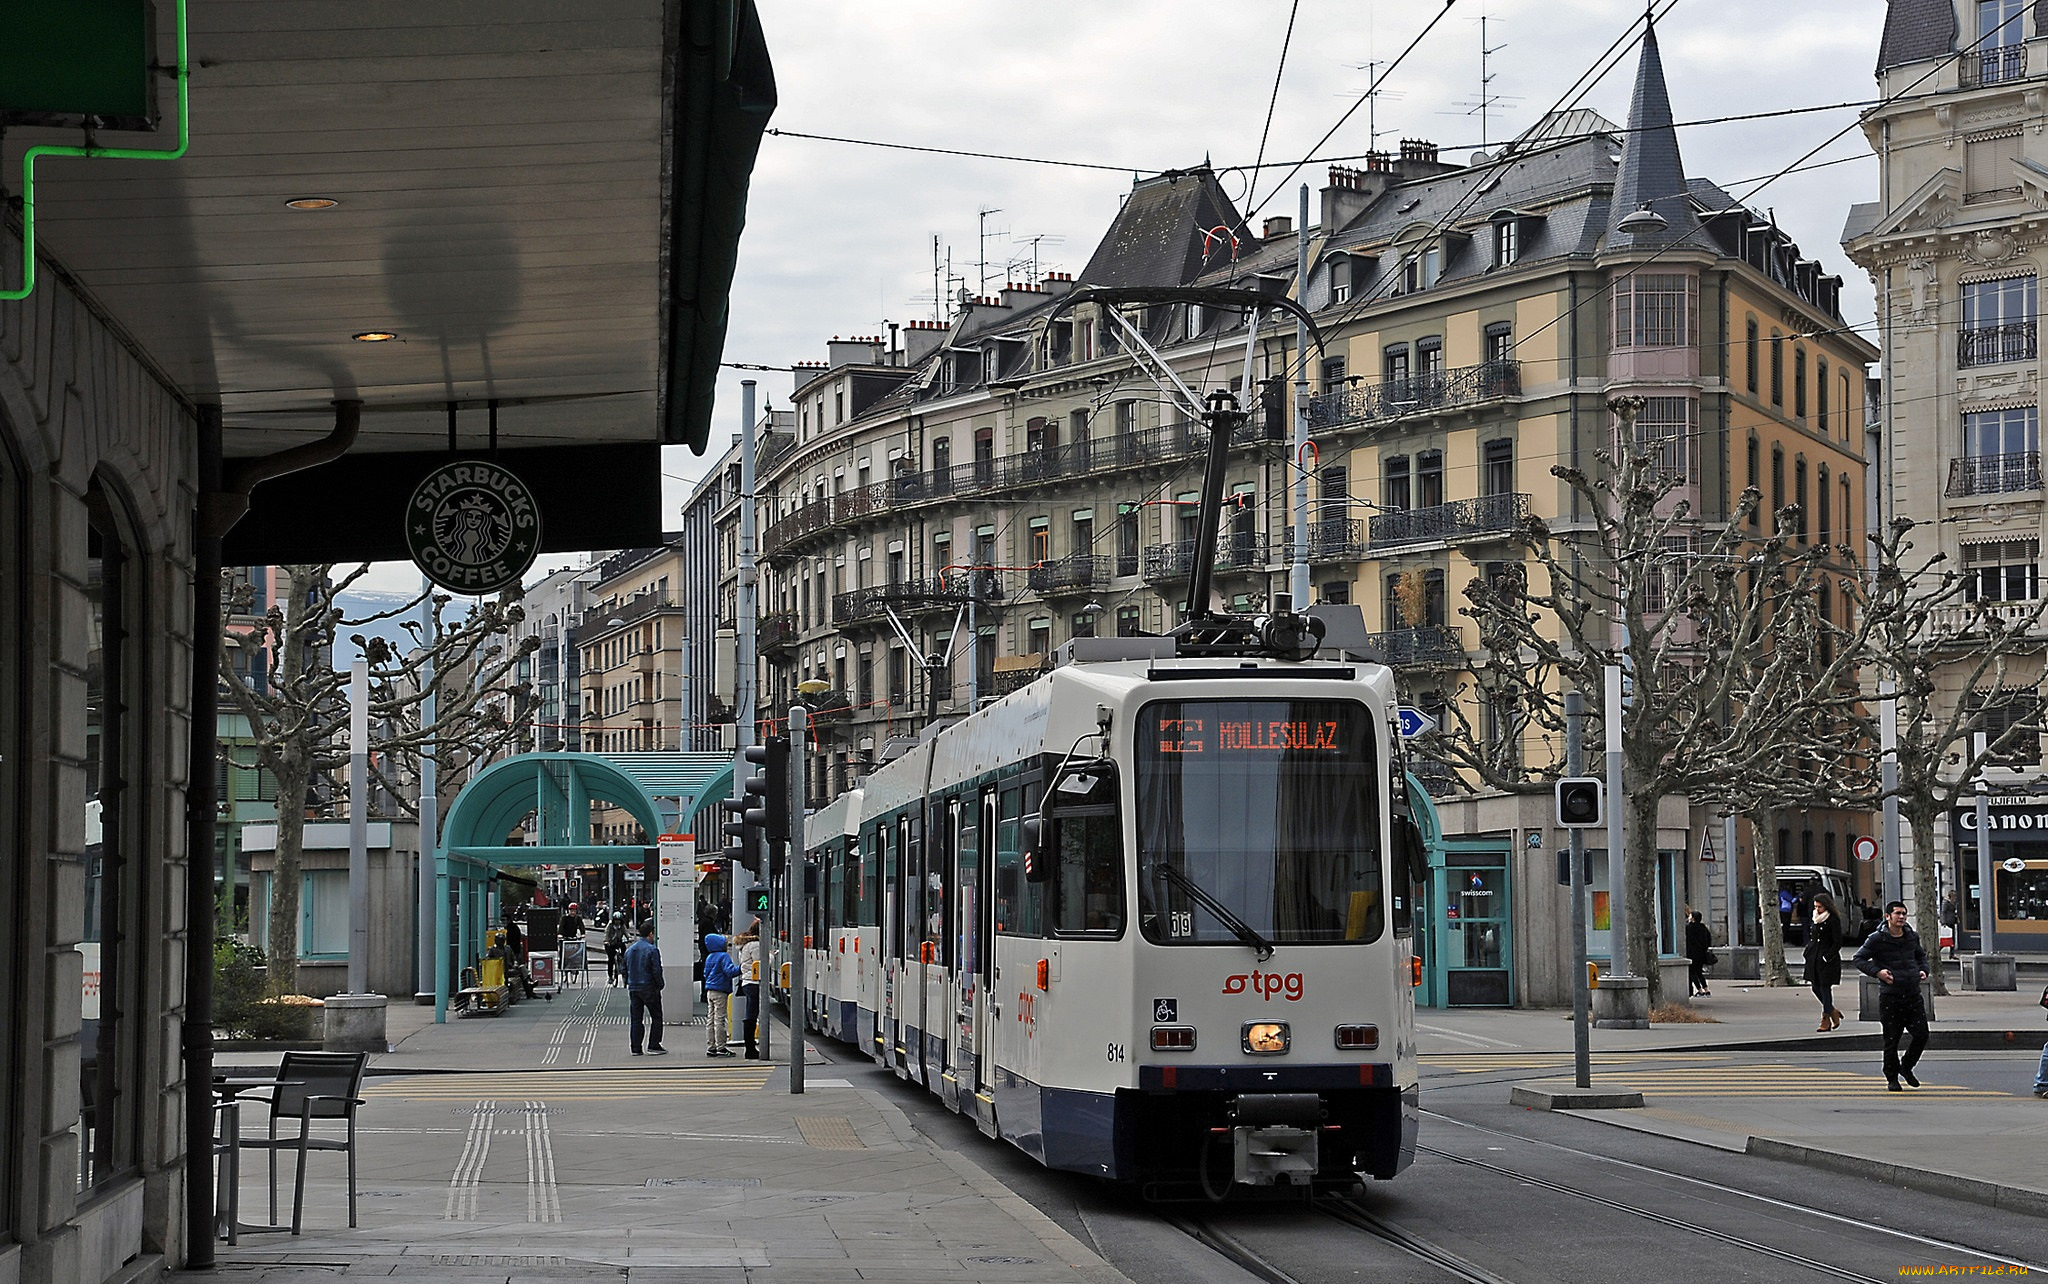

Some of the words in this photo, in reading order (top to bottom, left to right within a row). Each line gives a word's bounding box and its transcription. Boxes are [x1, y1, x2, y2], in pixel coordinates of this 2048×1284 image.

[416, 466, 534, 528] STARBUCKS
[421, 546, 511, 585] COFFEE
[1220, 722, 1337, 749] MOILLESULAZ
[1960, 812, 2048, 829] Canon
[1461, 889, 1493, 897] swisscom
[1251, 969, 1304, 1002] tpg
[1107, 1042, 1125, 1063] 814
